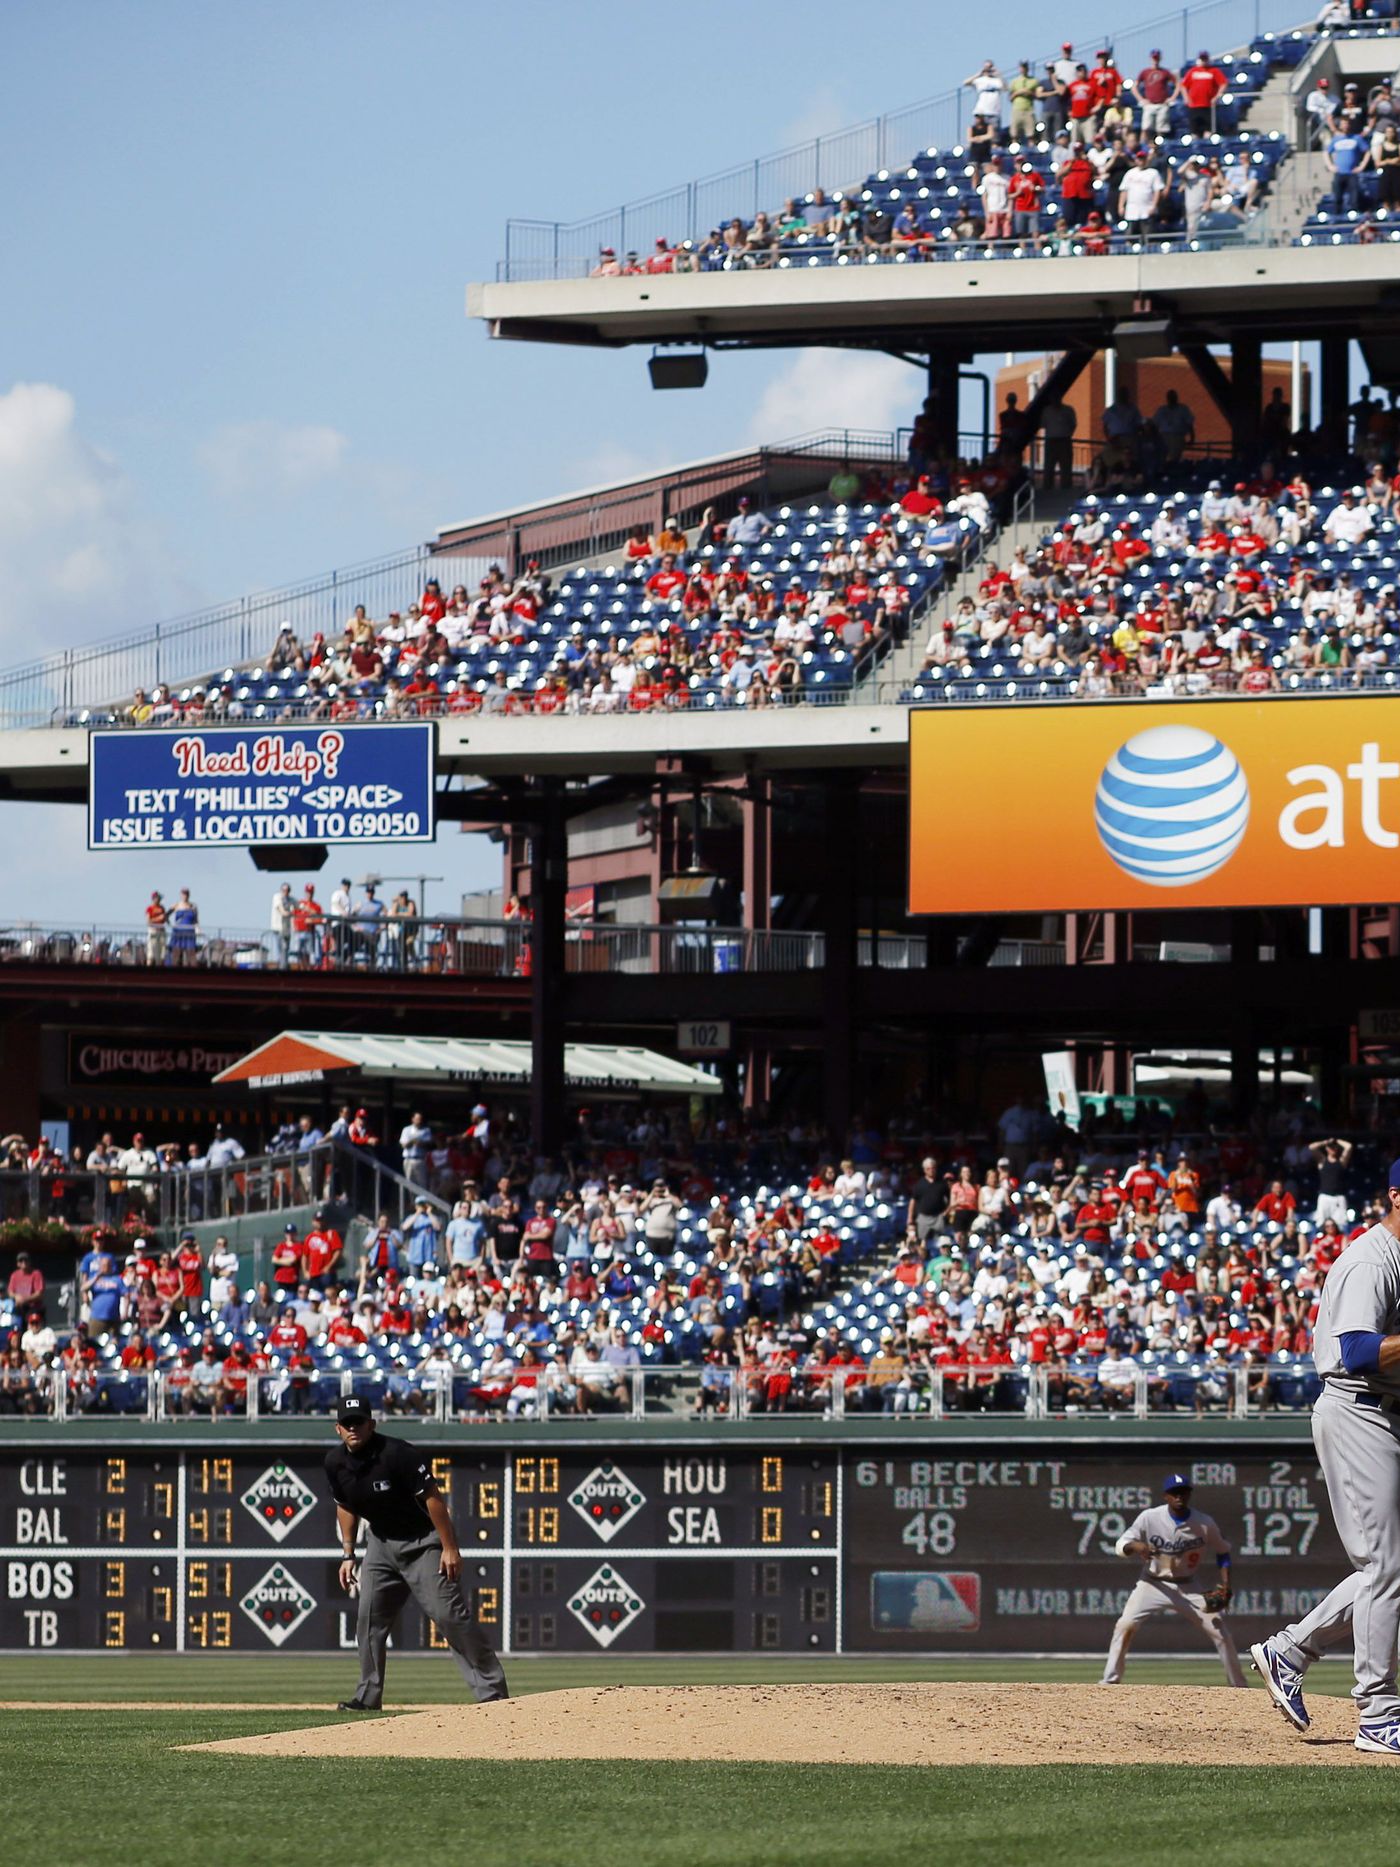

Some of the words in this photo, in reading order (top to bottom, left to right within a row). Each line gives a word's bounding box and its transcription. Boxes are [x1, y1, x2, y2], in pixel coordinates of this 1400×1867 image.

[171, 737, 249, 778] Need
[252, 730, 345, 785] Help?
[125, 789, 180, 814] TEXT
[302, 785, 404, 811] <SPACE>
[103, 818, 164, 843] ISSUE
[171, 818, 188, 841] &
[194, 815, 307, 841] LOCATION
[314, 813, 346, 838] TO
[348, 811, 421, 838] 69050
[689, 1025, 719, 1046] 102
[565, 1073, 609, 1086] WING
[18, 1458, 67, 1496] CLE
[106, 1458, 126, 1494] 2
[202, 1458, 234, 1494] 19
[257, 1481, 301, 1500] OUTS
[515, 1457, 560, 1494] 60
[586, 1482, 628, 1500] OUTS
[662, 1457, 728, 1496] HOU
[761, 1457, 783, 1494] 0
[855, 1462, 896, 1487] 61
[910, 1461, 1067, 1488] BECKETT
[1190, 1463, 1238, 1486] ERA
[154, 1482, 173, 1518] 7
[823, 1482, 832, 1517] 1
[894, 1485, 968, 1510] BALLS
[1048, 1485, 1153, 1510] STRIKES
[1241, 1486, 1316, 1510] TOTAL
[16, 1507, 69, 1545] BAL
[106, 1508, 126, 1543] 4
[188, 1508, 233, 1543] 41
[527, 1507, 560, 1543] 18
[667, 1506, 722, 1544] SEA
[761, 1507, 783, 1543] 0
[901, 1511, 957, 1556] 48
[1070, 1511, 1128, 1556] 79
[1239, 1511, 1320, 1556] 127
[7, 1561, 75, 1600] BOS
[106, 1562, 126, 1598] 3
[188, 1562, 233, 1598] 51
[257, 1584, 301, 1604] OUTS
[585, 1586, 627, 1604] OUTS
[153, 1586, 172, 1622] 7
[479, 1587, 498, 1623] 2
[996, 1588, 1070, 1616] MAJOR
[24, 1610, 59, 1648] TB
[106, 1611, 126, 1648] 3
[188, 1611, 232, 1648] 43
